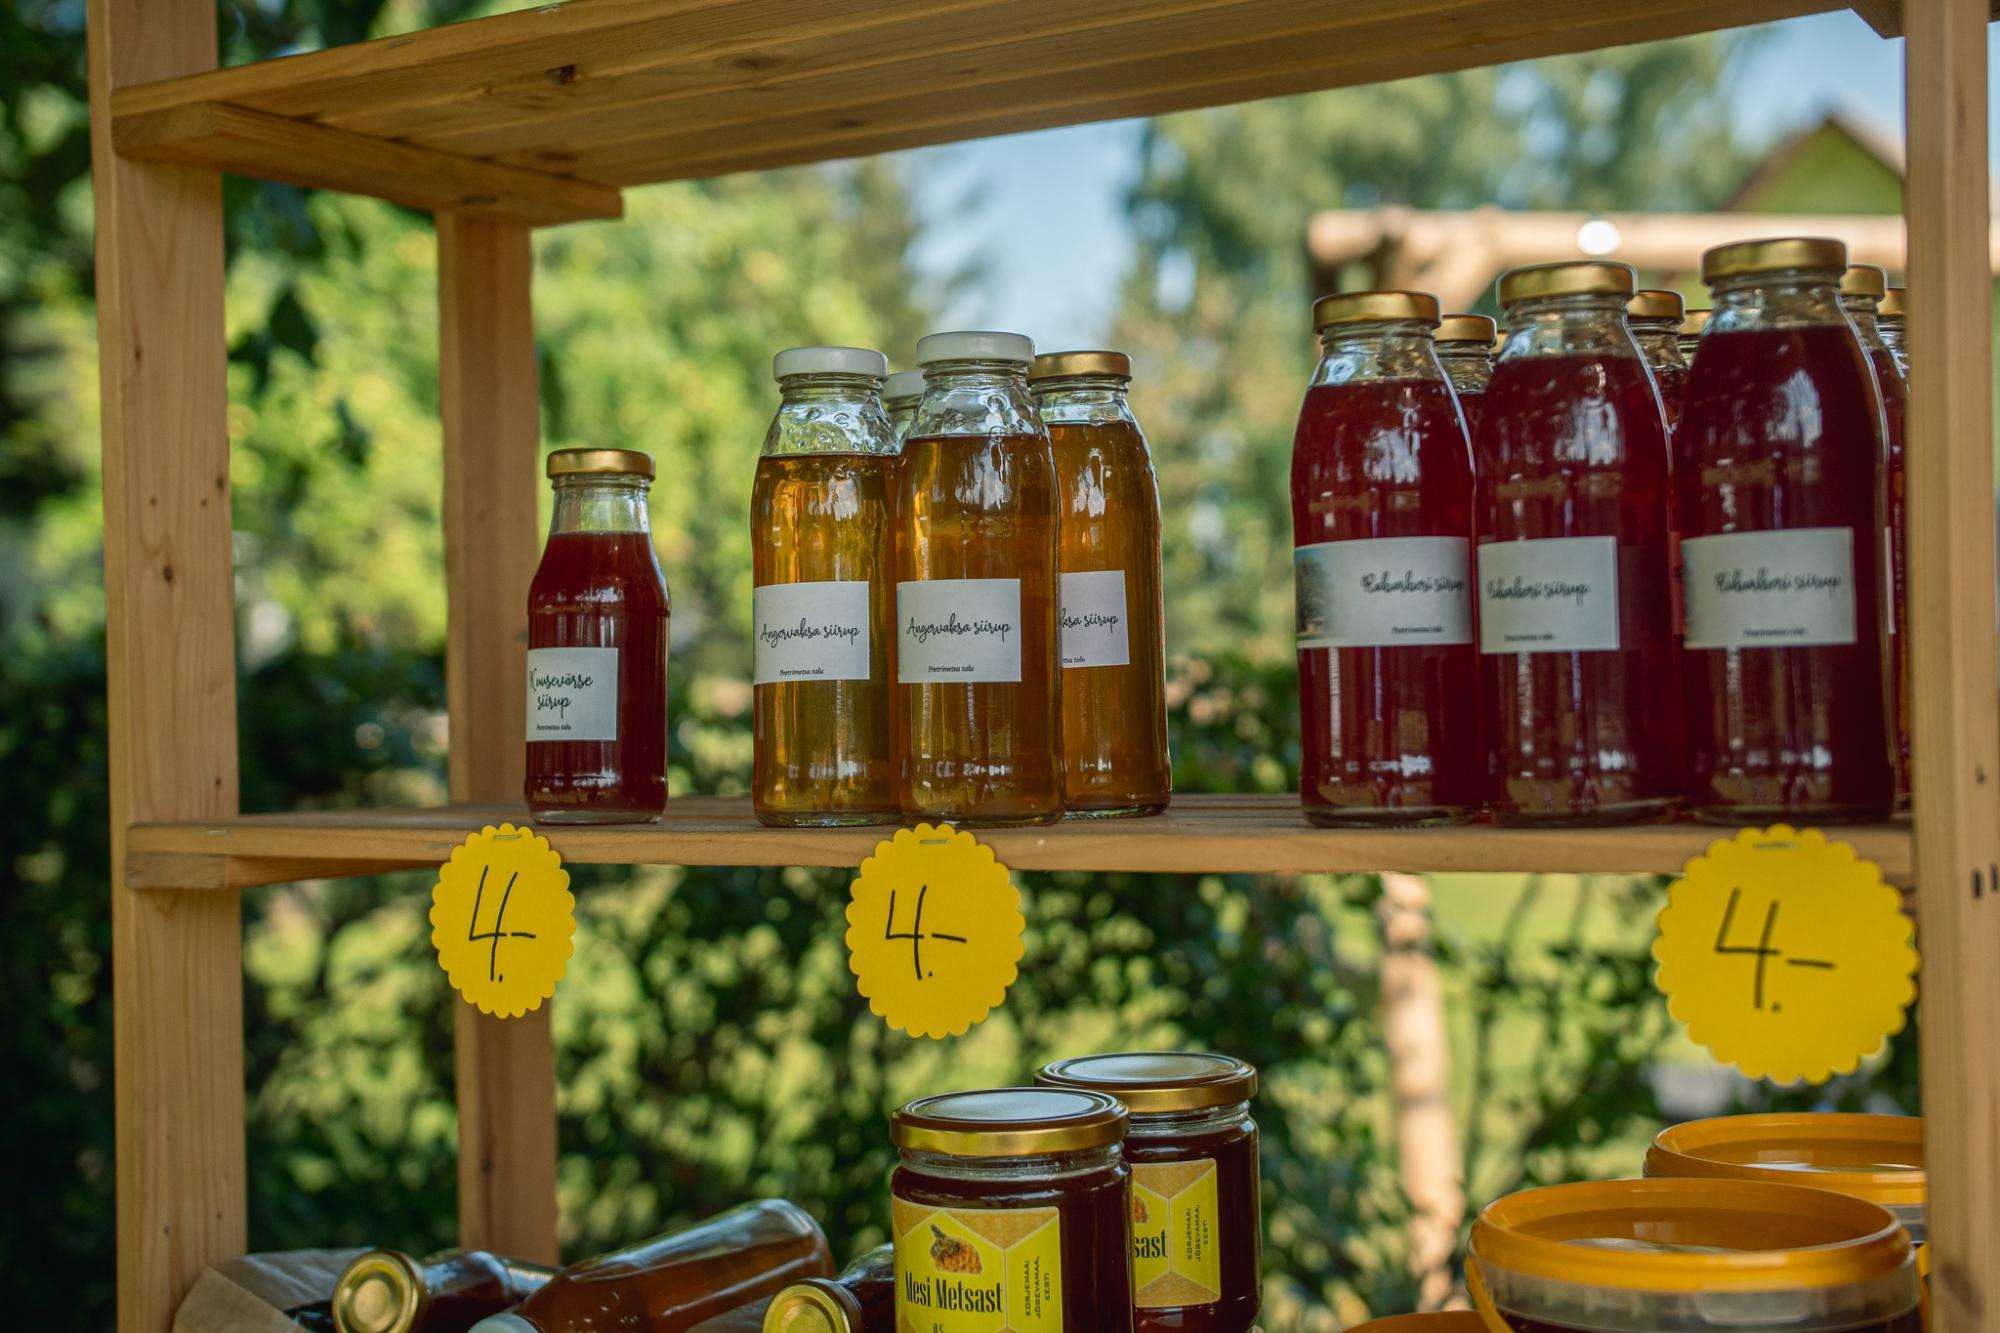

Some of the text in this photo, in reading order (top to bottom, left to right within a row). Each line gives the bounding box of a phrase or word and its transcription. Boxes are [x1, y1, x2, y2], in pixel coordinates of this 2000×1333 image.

[760, 617, 860, 648] Angervaksa siirup
[907, 612, 1011, 643] Angervaksa siirup
[1083, 613, 1118, 633] siirup
[537, 693, 572, 719] siirup
[905, 1271, 1004, 1313] Mesi Metsast
